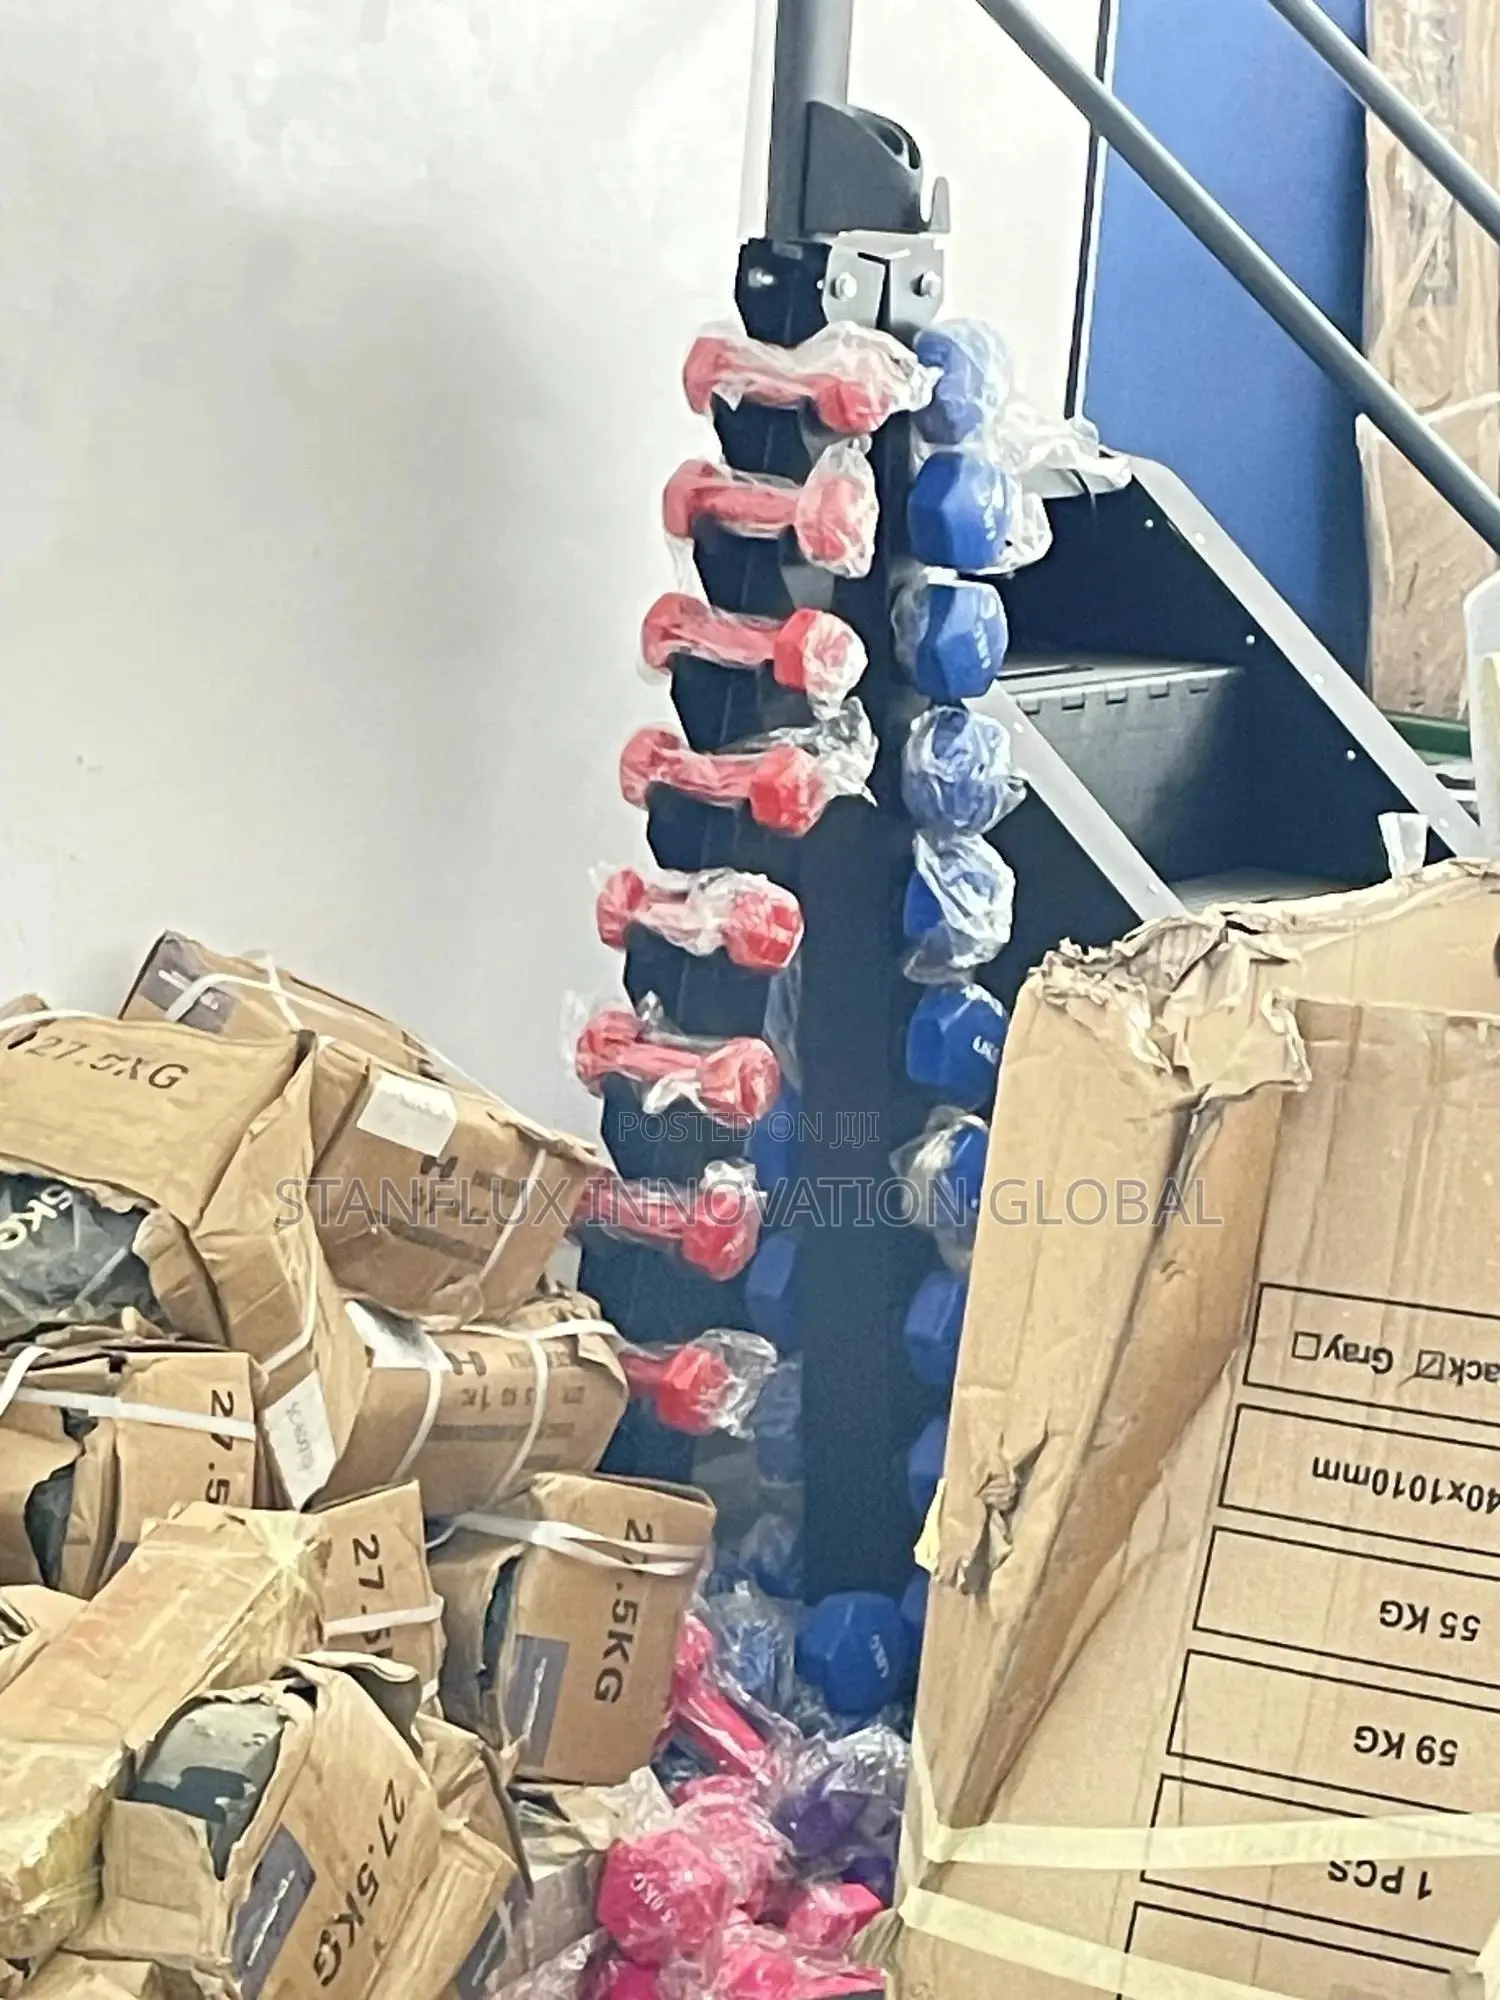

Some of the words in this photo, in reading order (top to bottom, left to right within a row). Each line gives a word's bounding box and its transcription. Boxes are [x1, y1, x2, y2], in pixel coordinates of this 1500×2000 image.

[1323, 1333, 1394, 1375] Gray
[1379, 1600, 1430, 1634] KG
[1439, 1611, 1481, 1642] 55
[1353, 1725, 1405, 1760] KG
[1415, 1735, 1459, 1767] 59
[313, 1779, 405, 1987] 27.5KG
[1417, 1871, 1432, 1901] 1
